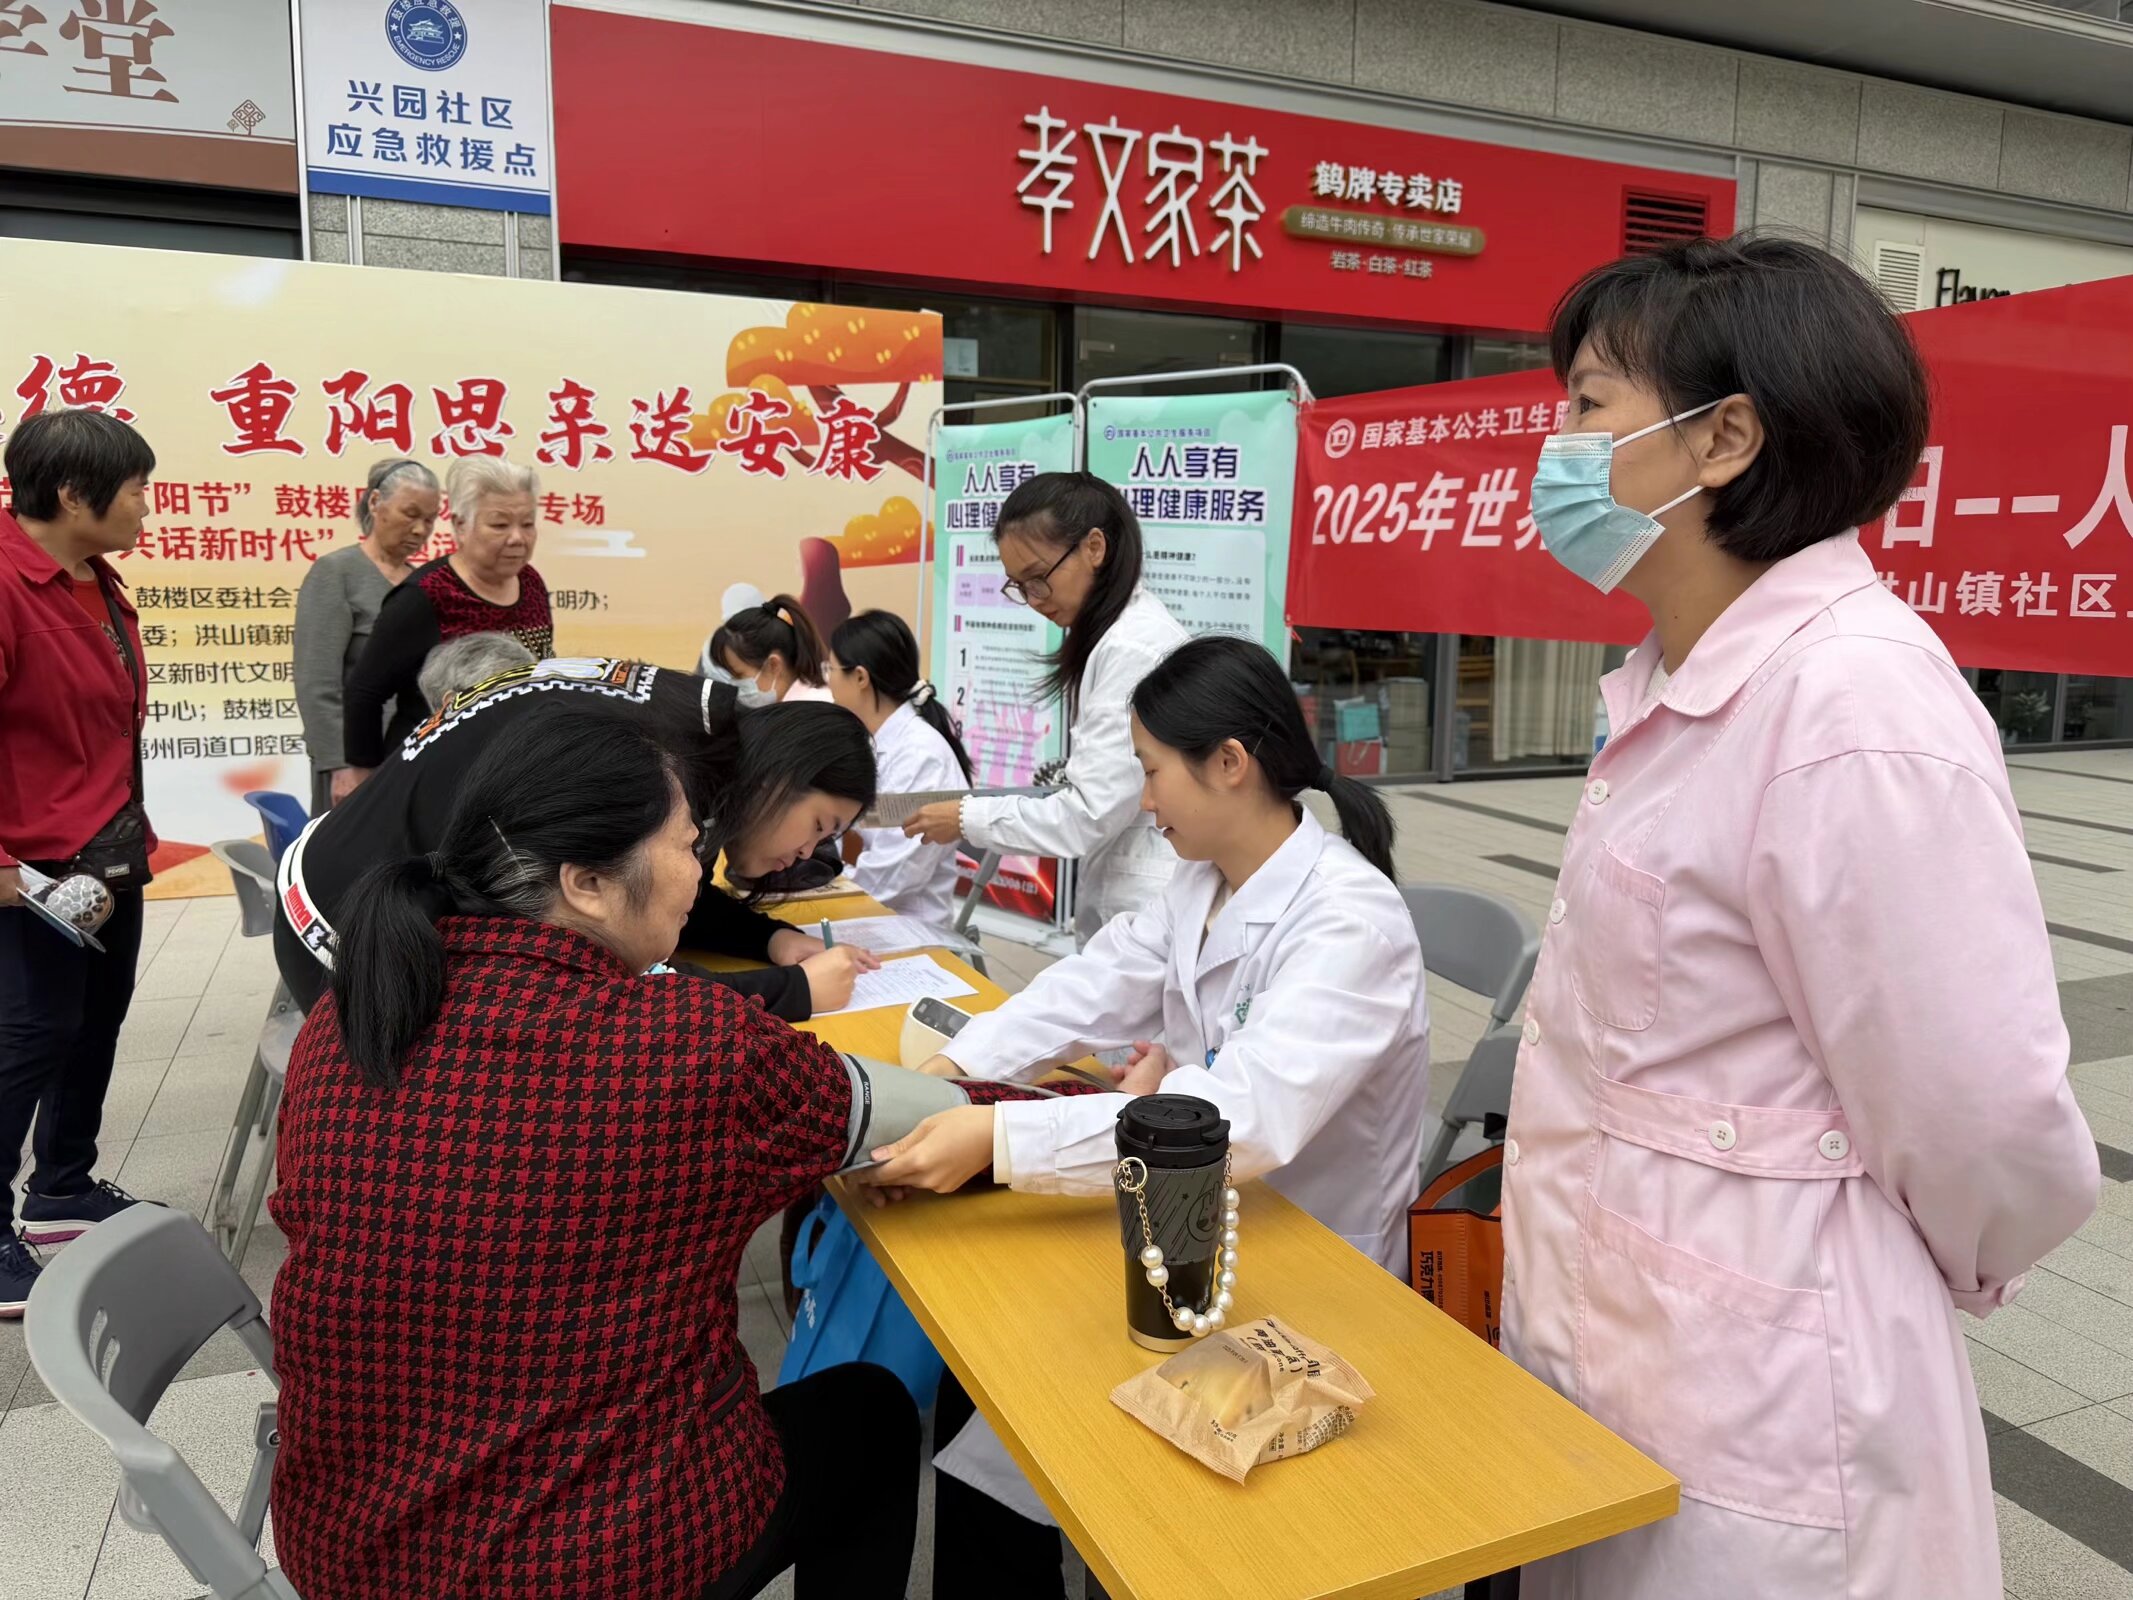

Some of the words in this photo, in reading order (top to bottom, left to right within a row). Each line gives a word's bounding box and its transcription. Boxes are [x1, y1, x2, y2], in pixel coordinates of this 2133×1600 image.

[394, 35, 434, 66] EMERGENCY
[436, 43, 460, 65] RESCUE
[347, 79, 514, 130] 兴园社区
[327, 123, 536, 177] 应急救援点
[1016, 105, 1269, 273] 孝文家茶
[209, 360, 886, 482] 重阳思亲送安康
[1131, 446, 1237, 479] 人人享有
[538, 492, 605, 526] 专场
[947, 502, 1004, 528] 心理健
[1118, 488, 1265, 522] 理健康服务
[548, 589, 608, 610] 明办；
[1878, 571, 2133, 618] 山镇社区
[960, 648, 966, 667] 1
[957, 687, 965, 706] 2
